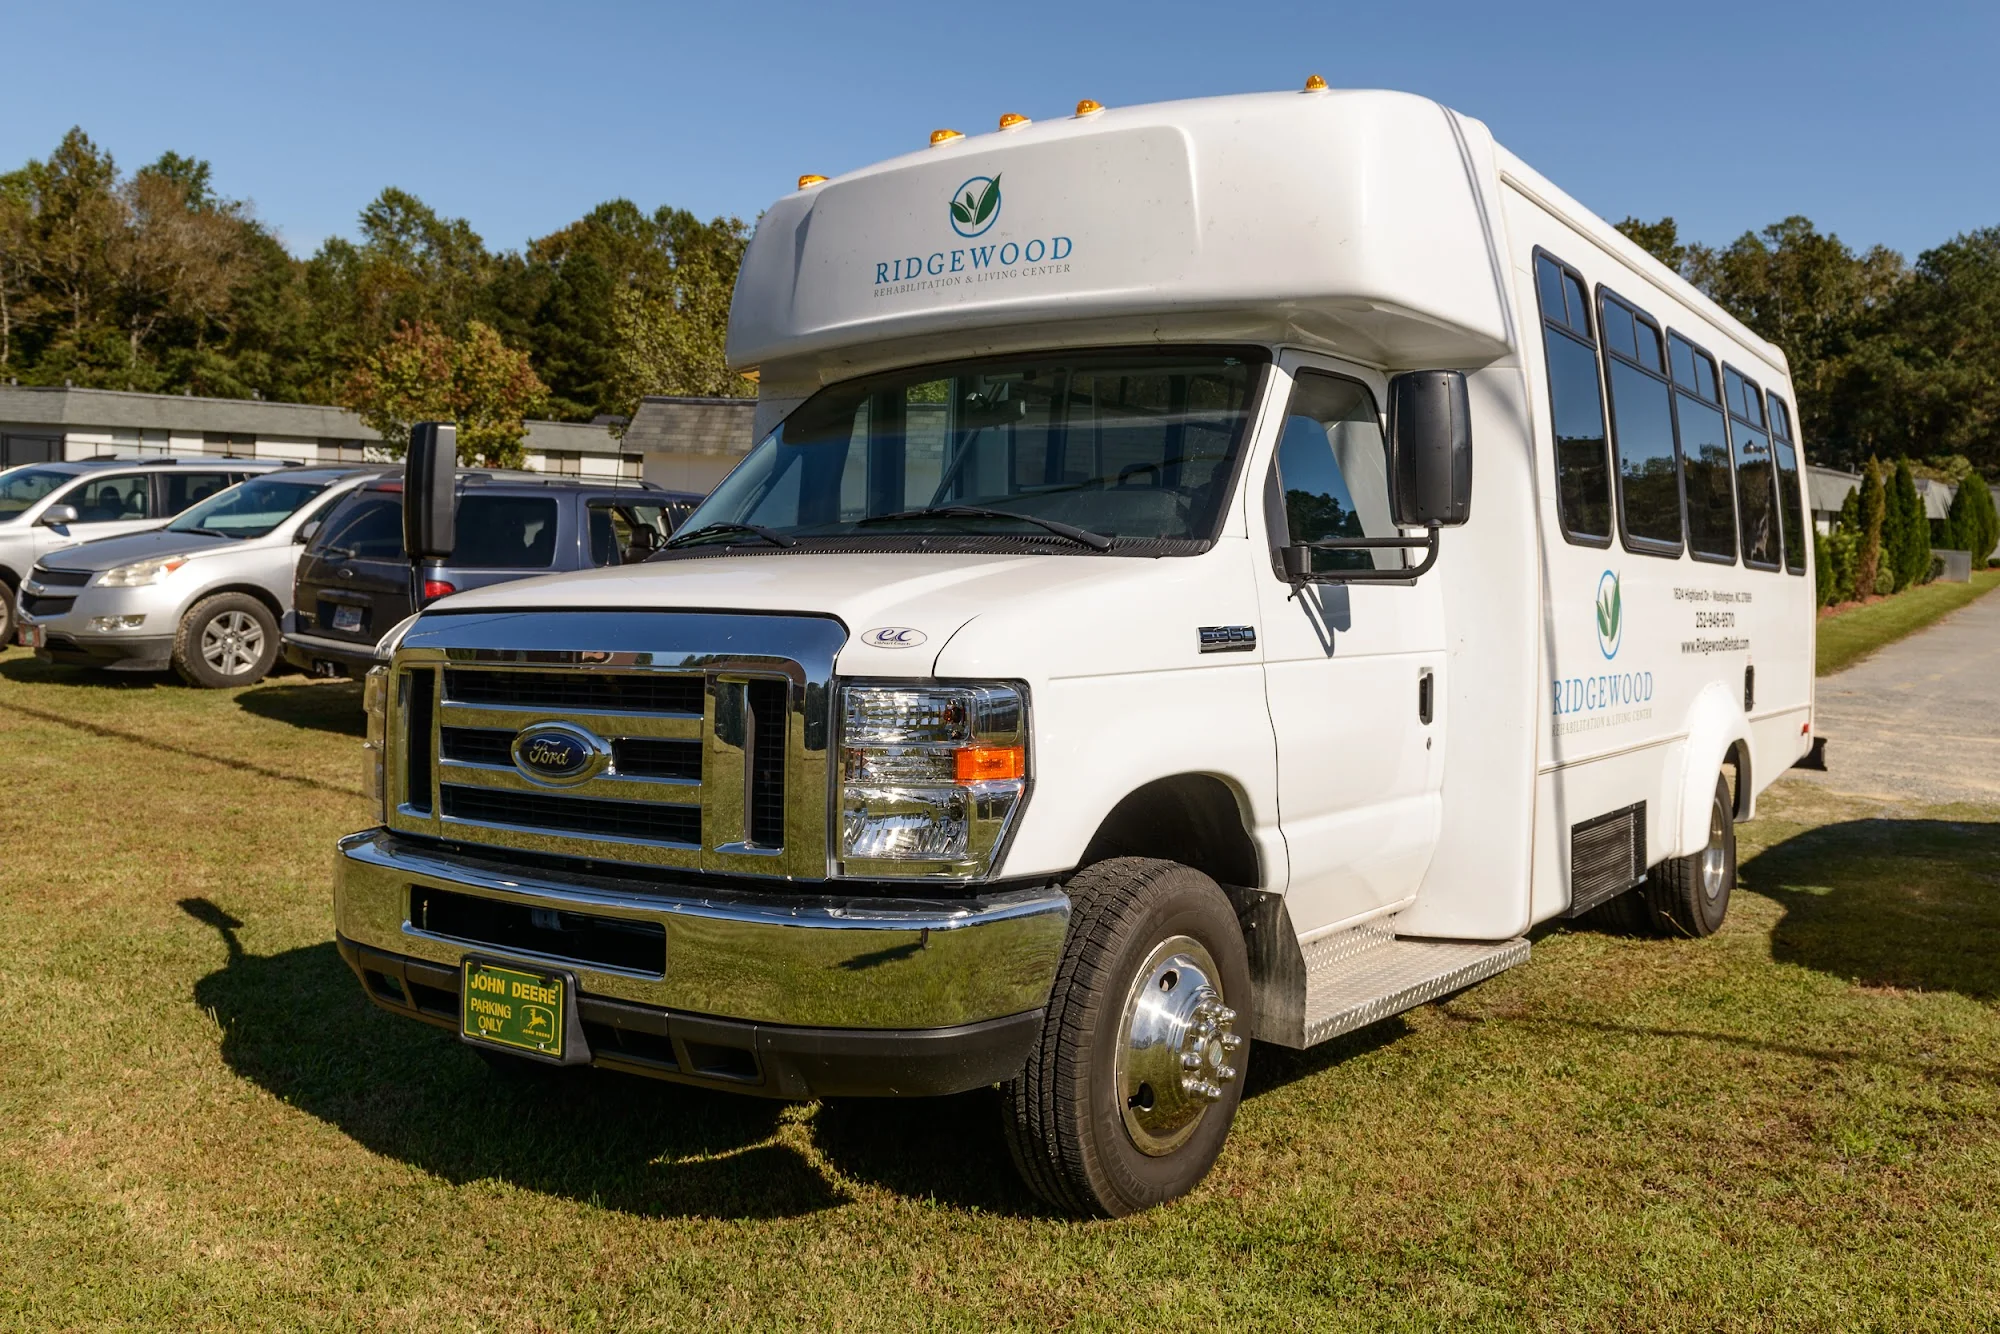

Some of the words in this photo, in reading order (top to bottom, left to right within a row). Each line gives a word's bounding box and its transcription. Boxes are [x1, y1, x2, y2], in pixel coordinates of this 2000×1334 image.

[875, 236, 1073, 285] RIDGEWOOD
[873, 276, 961, 298] REHABILITATION
[965, 275, 974, 284] &
[977, 269, 1018, 282] LIVING
[1022, 263, 1071, 277] CENTER
[1695, 611, 1735, 628] 252-946-9570
[1552, 671, 1653, 716] RIDGEWOOD
[1551, 715, 1605, 738] REHABILITATION
[1632, 708, 1653, 722] CENTER
[529, 738, 571, 766] Ford
[470, 973, 505, 995] JOHN
[511, 981, 556, 1006] DEERE
[470, 997, 512, 1019] PARKING
[478, 1015, 503, 1033] ONLY
